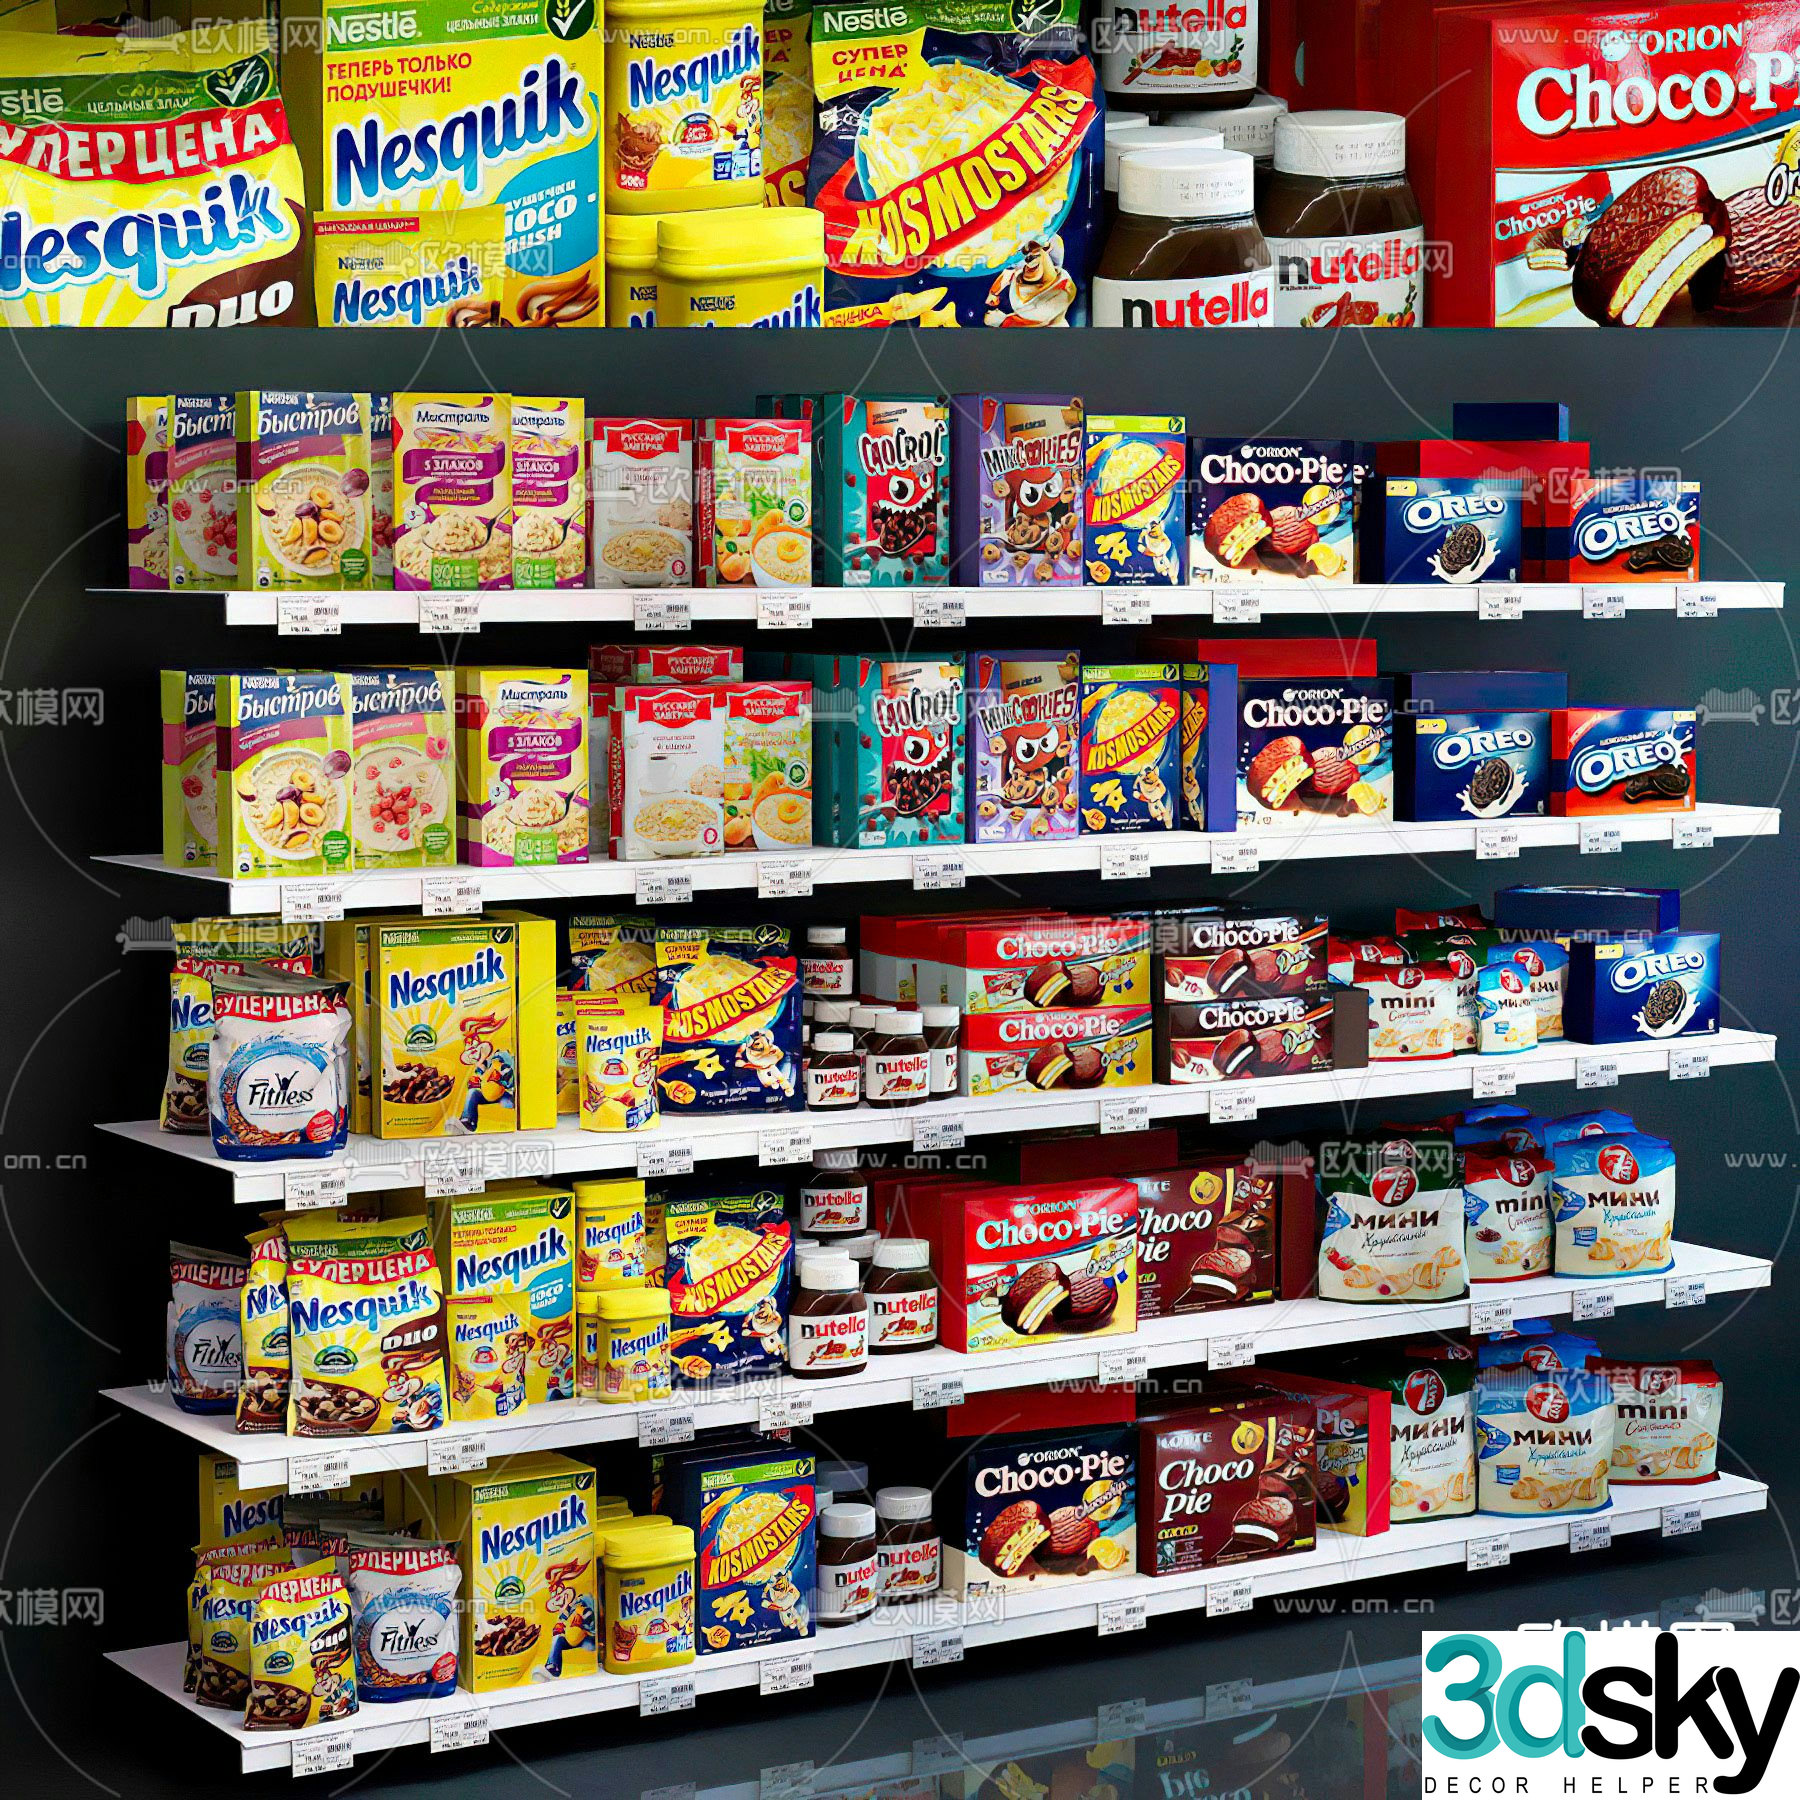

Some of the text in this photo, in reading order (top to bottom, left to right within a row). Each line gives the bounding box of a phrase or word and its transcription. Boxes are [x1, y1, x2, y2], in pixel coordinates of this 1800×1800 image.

[327, 9, 422, 45] Nestlé
[823, 6, 911, 33] Nestlé
[831, 43, 909, 66] СУПЕР
[1642, 23, 1746, 56] ORION
[327, 52, 473, 81] ТЕПЕРЬ ТОЛЬКО
[630, 24, 761, 109] Nesquik
[327, 76, 453, 103] ПОДУШЕЧКИ!
[336, 58, 586, 208] Nesquik
[1279, 237, 1422, 288] nutella
[333, 257, 481, 326] Nesquik
[1121, 279, 1268, 327] nutella
[258, 401, 361, 436] Быстров
[1091, 454, 1184, 523] KOSMOSTARS
[1407, 495, 1505, 528] OREO
[1584, 511, 1679, 552] OREO
[238, 682, 341, 721] Быстров
[1086, 700, 1178, 773] KOSMOSTARS
[1436, 729, 1533, 764] OREO
[1580, 741, 1676, 785] OREO
[390, 947, 505, 1010] Nesquik
[1613, 950, 1706, 984] OREO
[1381, 990, 1435, 1009] mini
[804, 1190, 863, 1208] nutella
[1588, 1189, 1661, 1209] МИНИ
[586, 1212, 644, 1249] Nesquik
[1350, 1211, 1440, 1231] МИНИ
[291, 1253, 430, 1284] СУПЕРЦЕНА
[457, 1227, 567, 1292] Nesquik
[290, 1280, 432, 1338] Nesquik
[874, 1292, 936, 1316] nutella
[455, 1313, 520, 1343] Nesquik
[611, 1322, 669, 1361] Nesquik
[801, 1316, 866, 1340] nutella
[1617, 1399, 1689, 1421] mini
[1390, 1415, 1465, 1443] МИНИ
[1512, 1427, 1593, 1447] МИНИ
[1158, 1458, 1255, 1491] Choco
[481, 1493, 588, 1563] Nesquik
[708, 1499, 811, 1586] KOSMOSTARS
[878, 1543, 938, 1568] nutella
[620, 1571, 692, 1618] Nesquik
[252, 1597, 343, 1646] Nesquik
